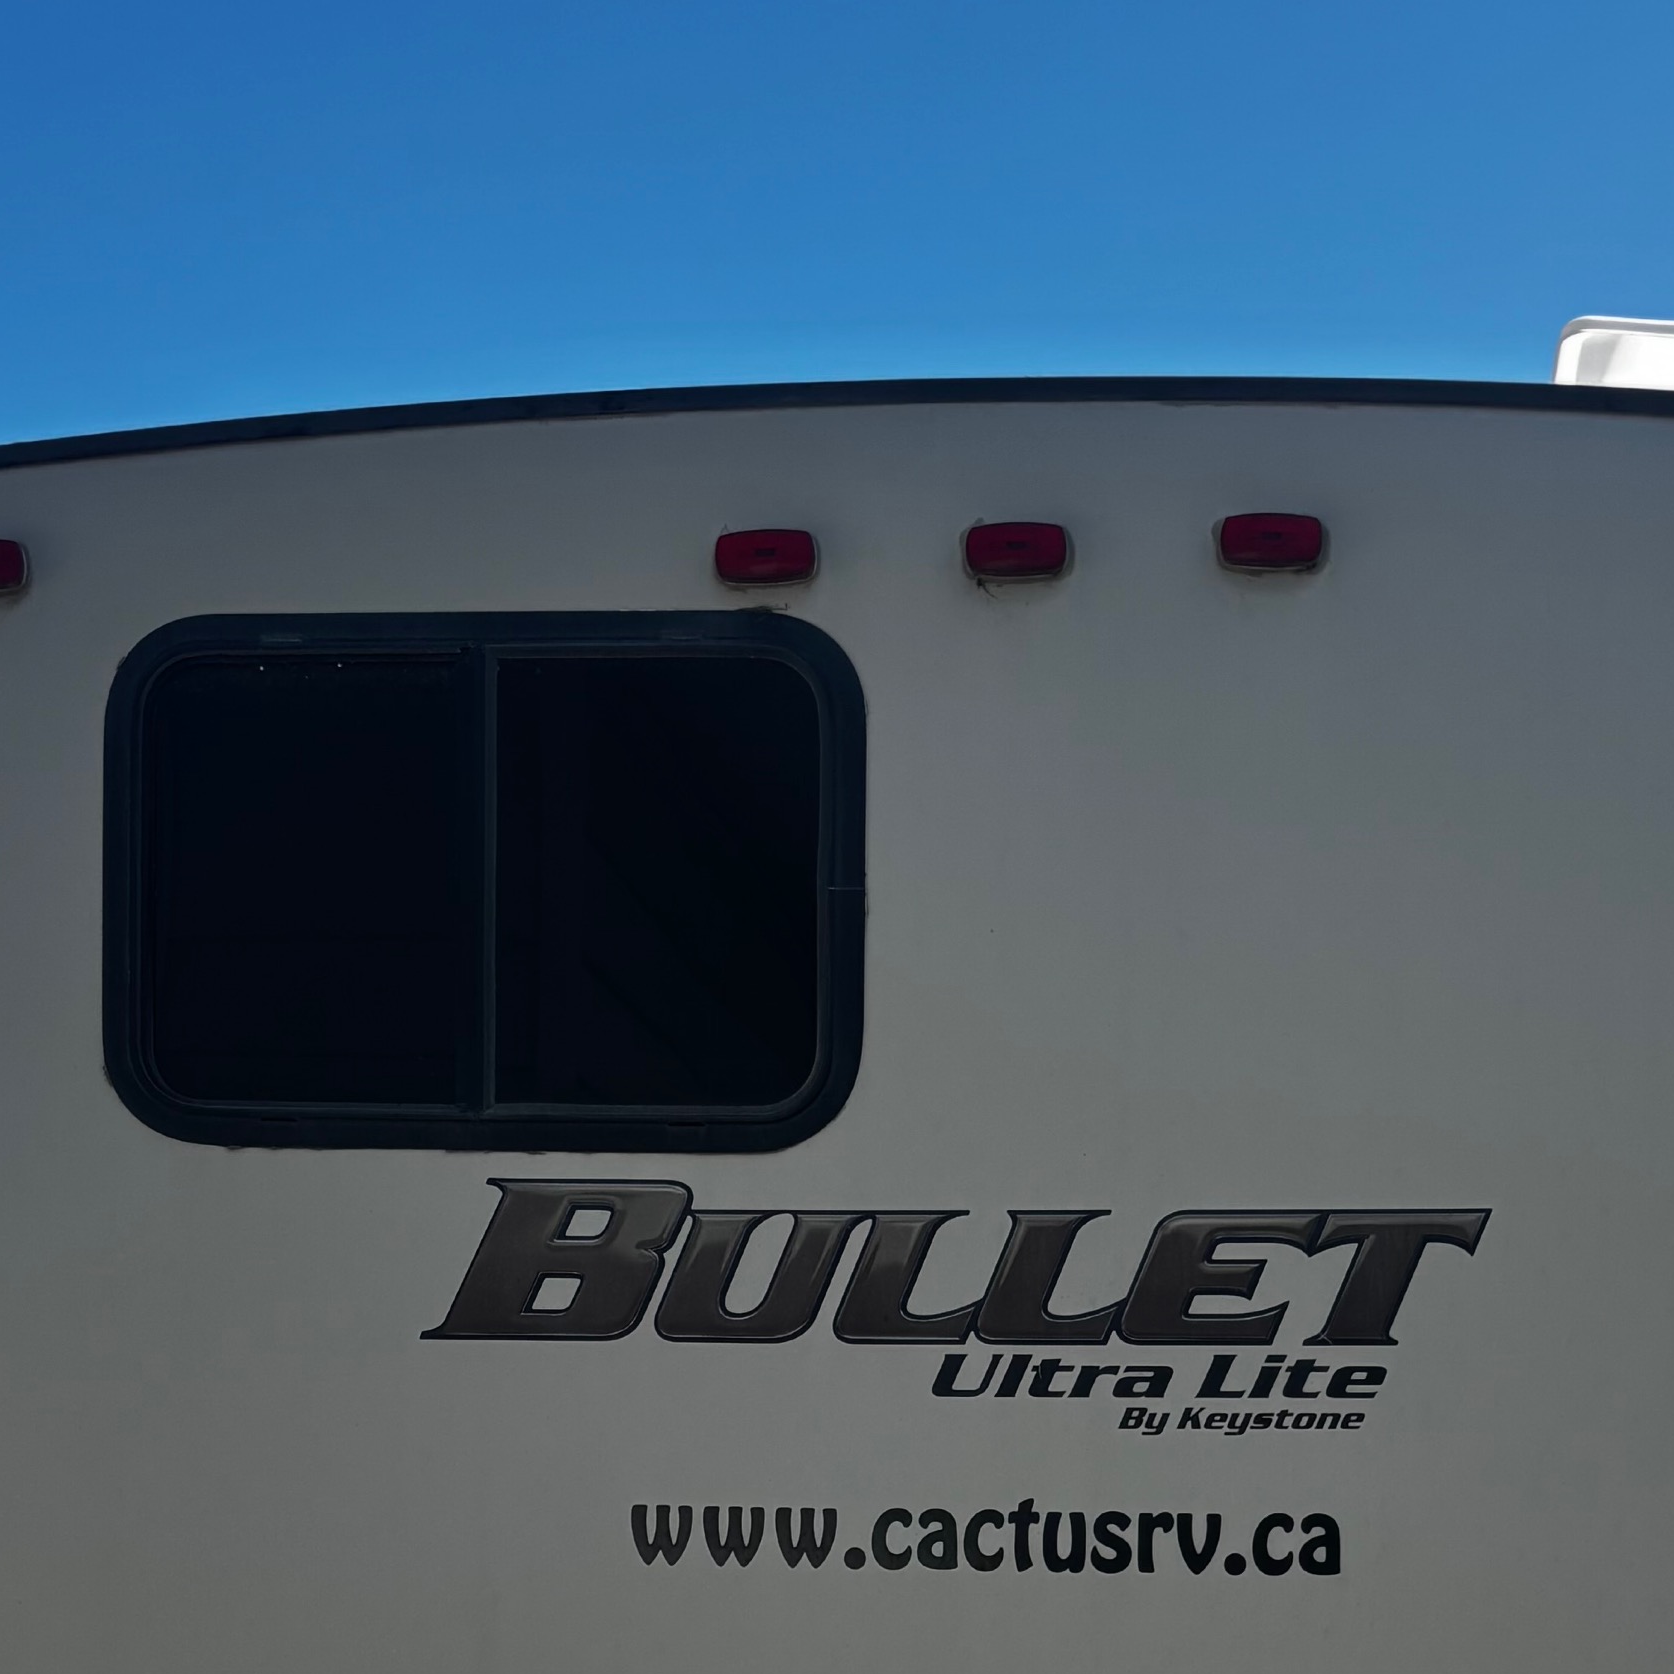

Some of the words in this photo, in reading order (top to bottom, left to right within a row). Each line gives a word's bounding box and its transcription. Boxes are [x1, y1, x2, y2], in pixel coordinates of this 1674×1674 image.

[419, 1177, 1493, 1346] BULLET
[930, 1353, 1174, 1399] Ultra
[1195, 1353, 1388, 1399] Lite
[1117, 1407, 1168, 1436] By
[1176, 1407, 1366, 1436] Keystone
[629, 1496, 1344, 1577] www.cactusrv.ca
